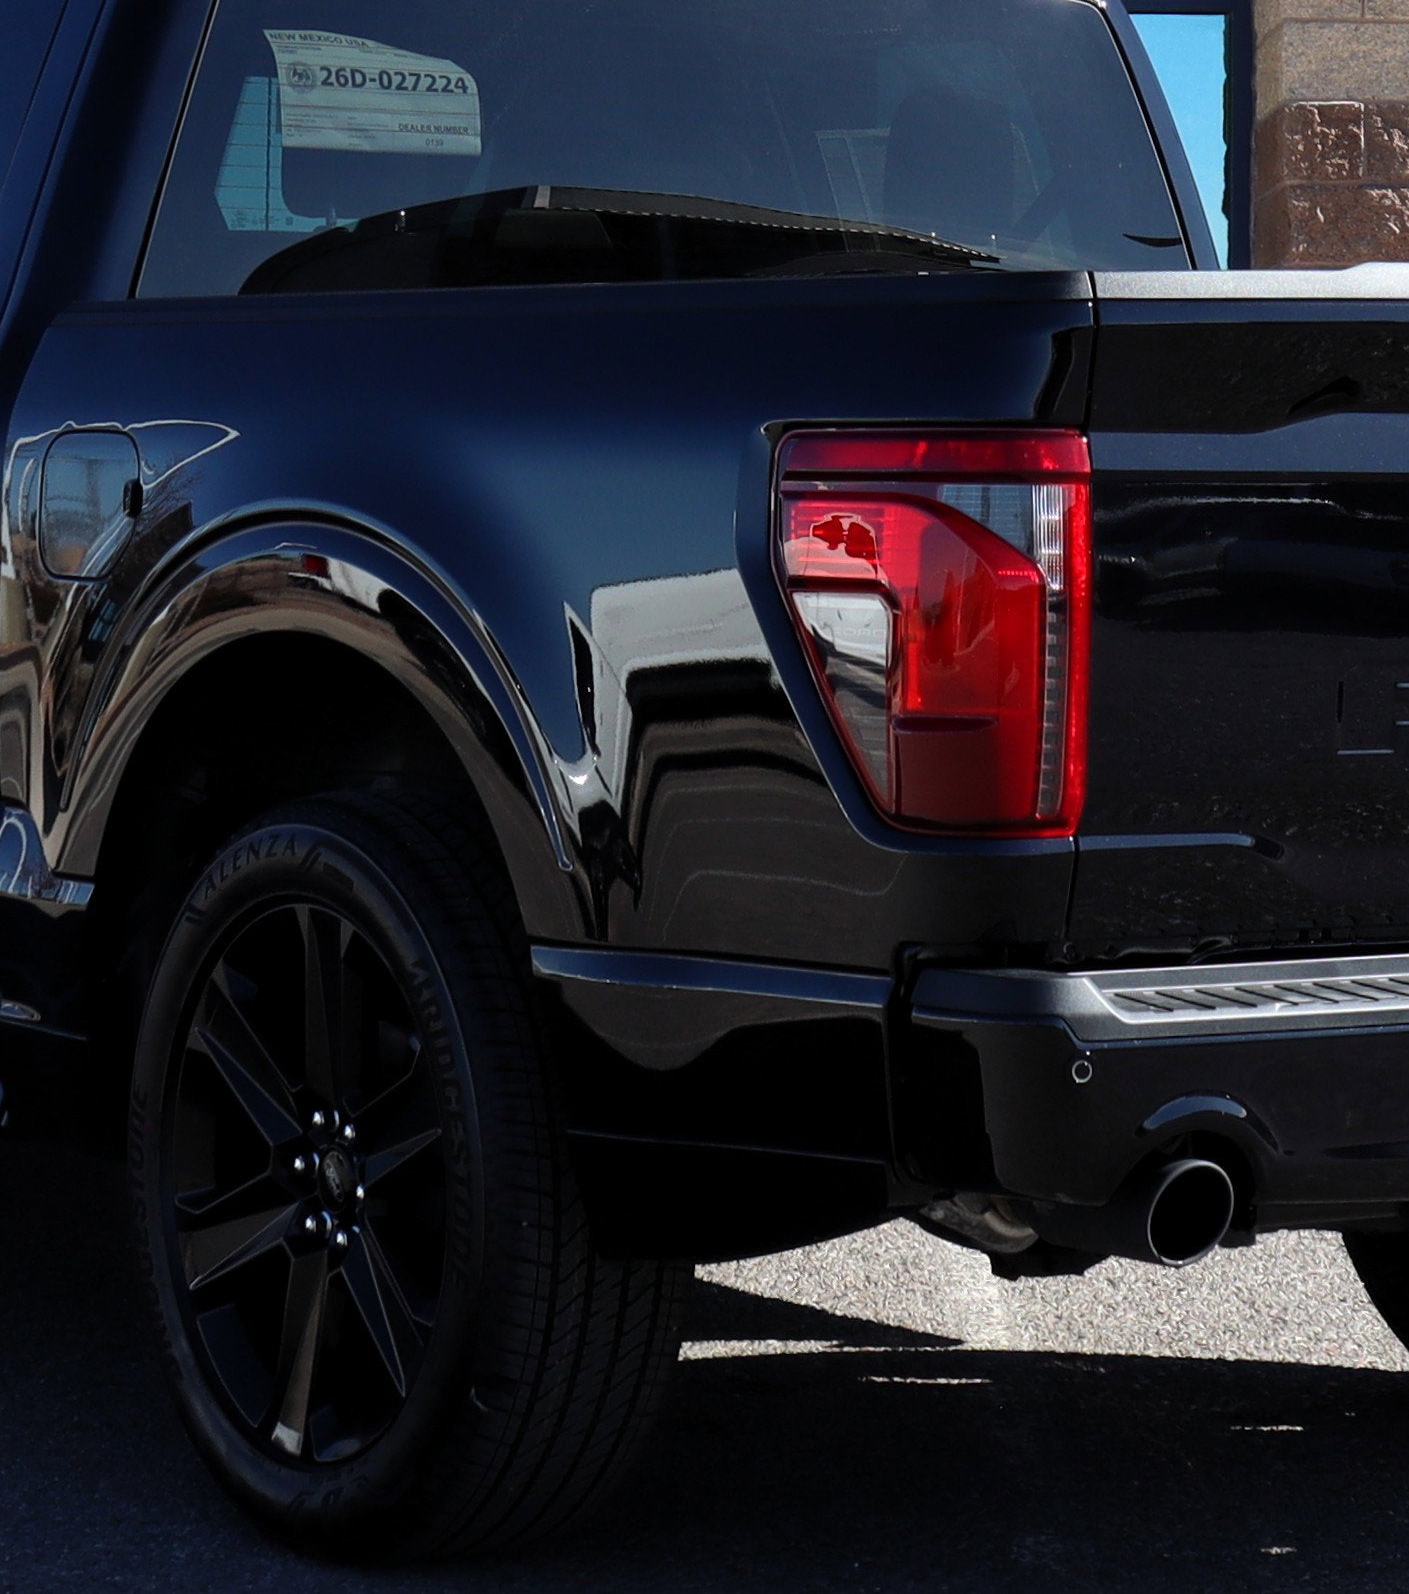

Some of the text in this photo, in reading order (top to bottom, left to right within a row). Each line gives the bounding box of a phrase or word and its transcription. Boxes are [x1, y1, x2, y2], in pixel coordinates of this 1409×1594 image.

[268, 31, 294, 43] NEW
[299, 32, 343, 46] MEXICO
[319, 65, 469, 94] 26D-027224
[398, 123, 430, 134] DEALER
[200, 832, 297, 901] ALENZA
